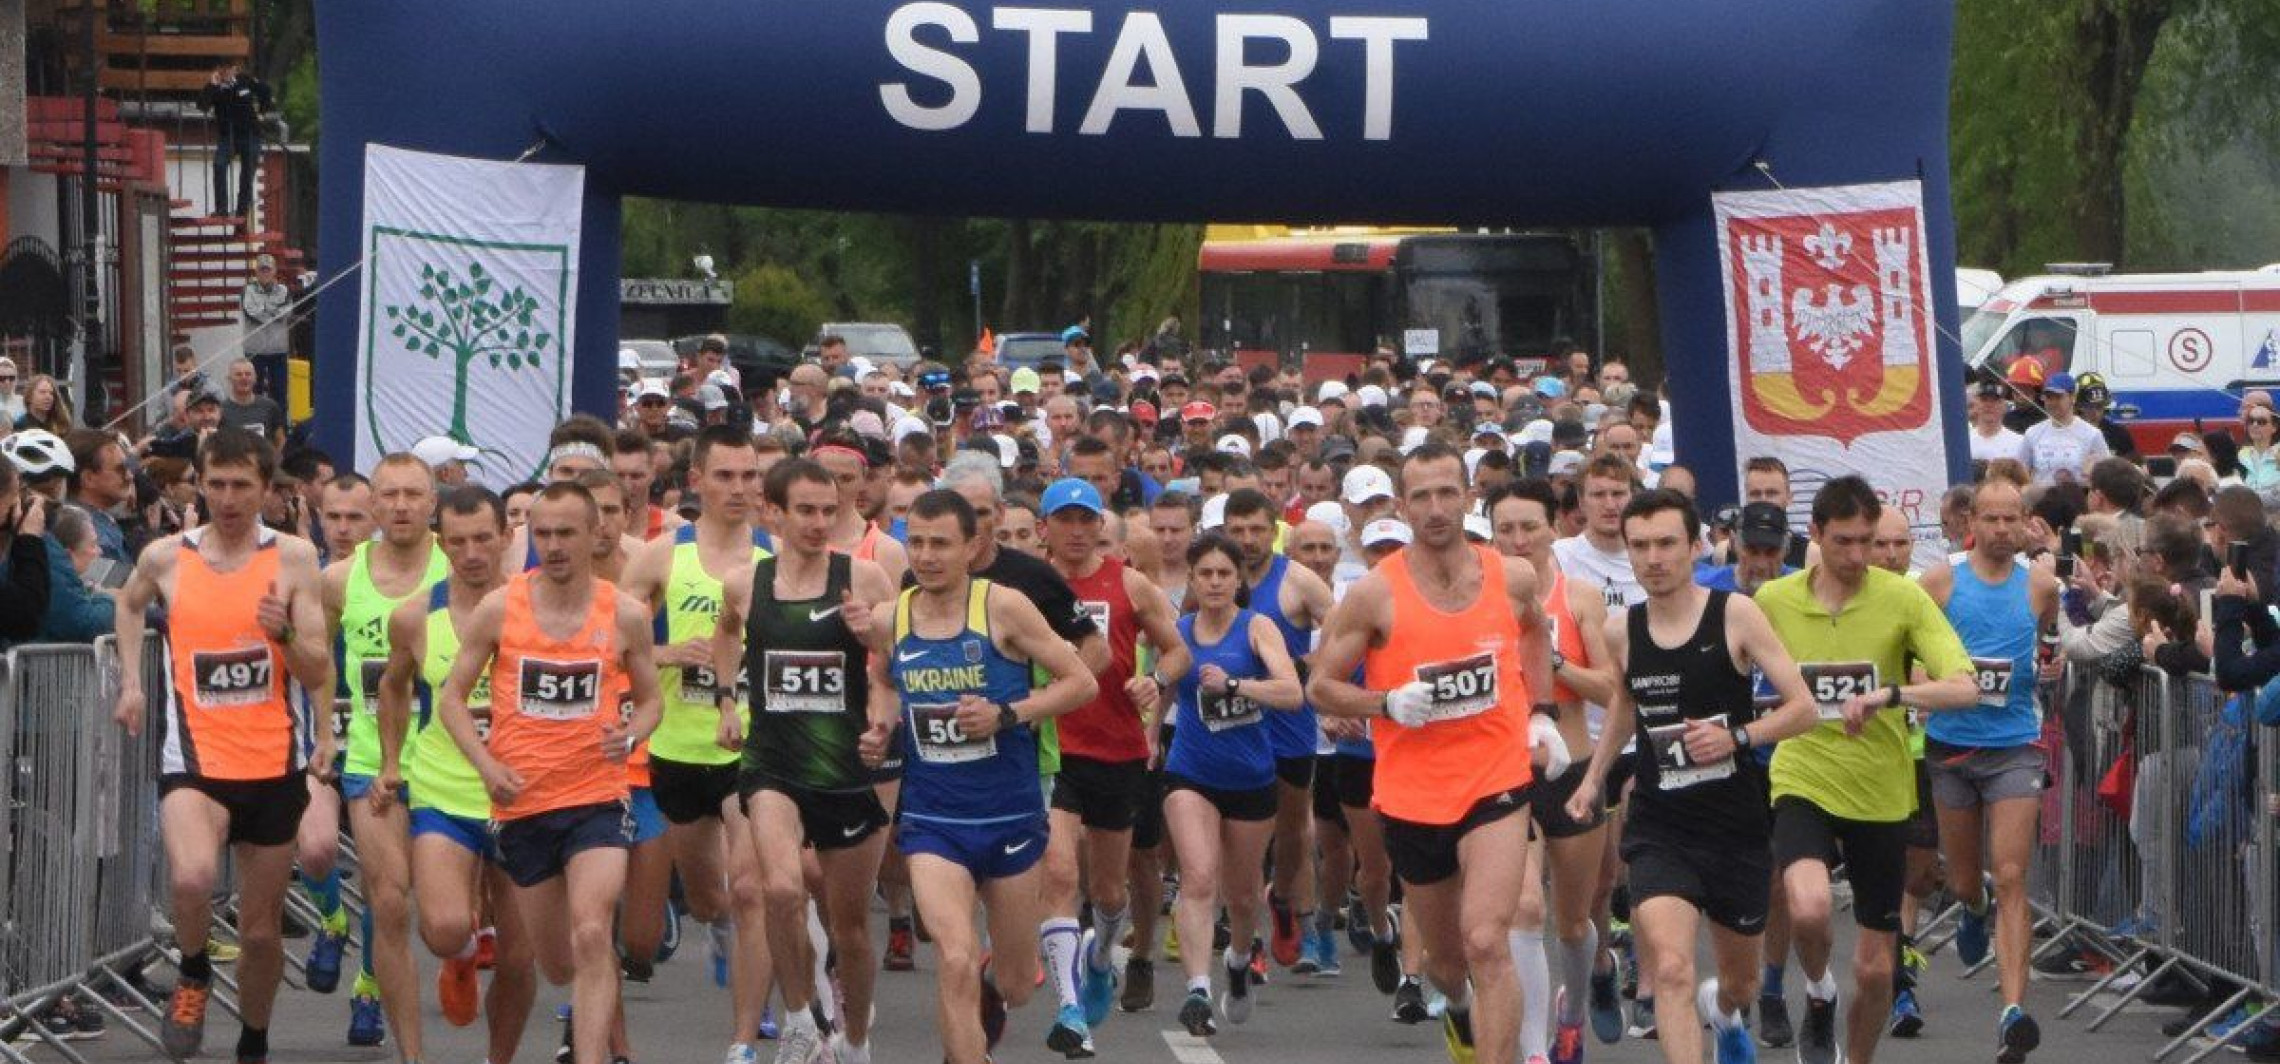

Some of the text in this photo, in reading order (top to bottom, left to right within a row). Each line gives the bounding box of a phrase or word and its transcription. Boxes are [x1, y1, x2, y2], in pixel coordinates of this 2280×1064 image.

[879, 2, 1428, 141] START
[2181, 337, 2199, 363] S
[210, 660, 270, 688] 497
[538, 673, 595, 700] 511
[782, 666, 844, 692] 513
[902, 665, 988, 693] UKRAINE
[1437, 665, 1495, 700] 507
[1815, 674, 1873, 701] 521
[1975, 669, 2010, 691] 87
